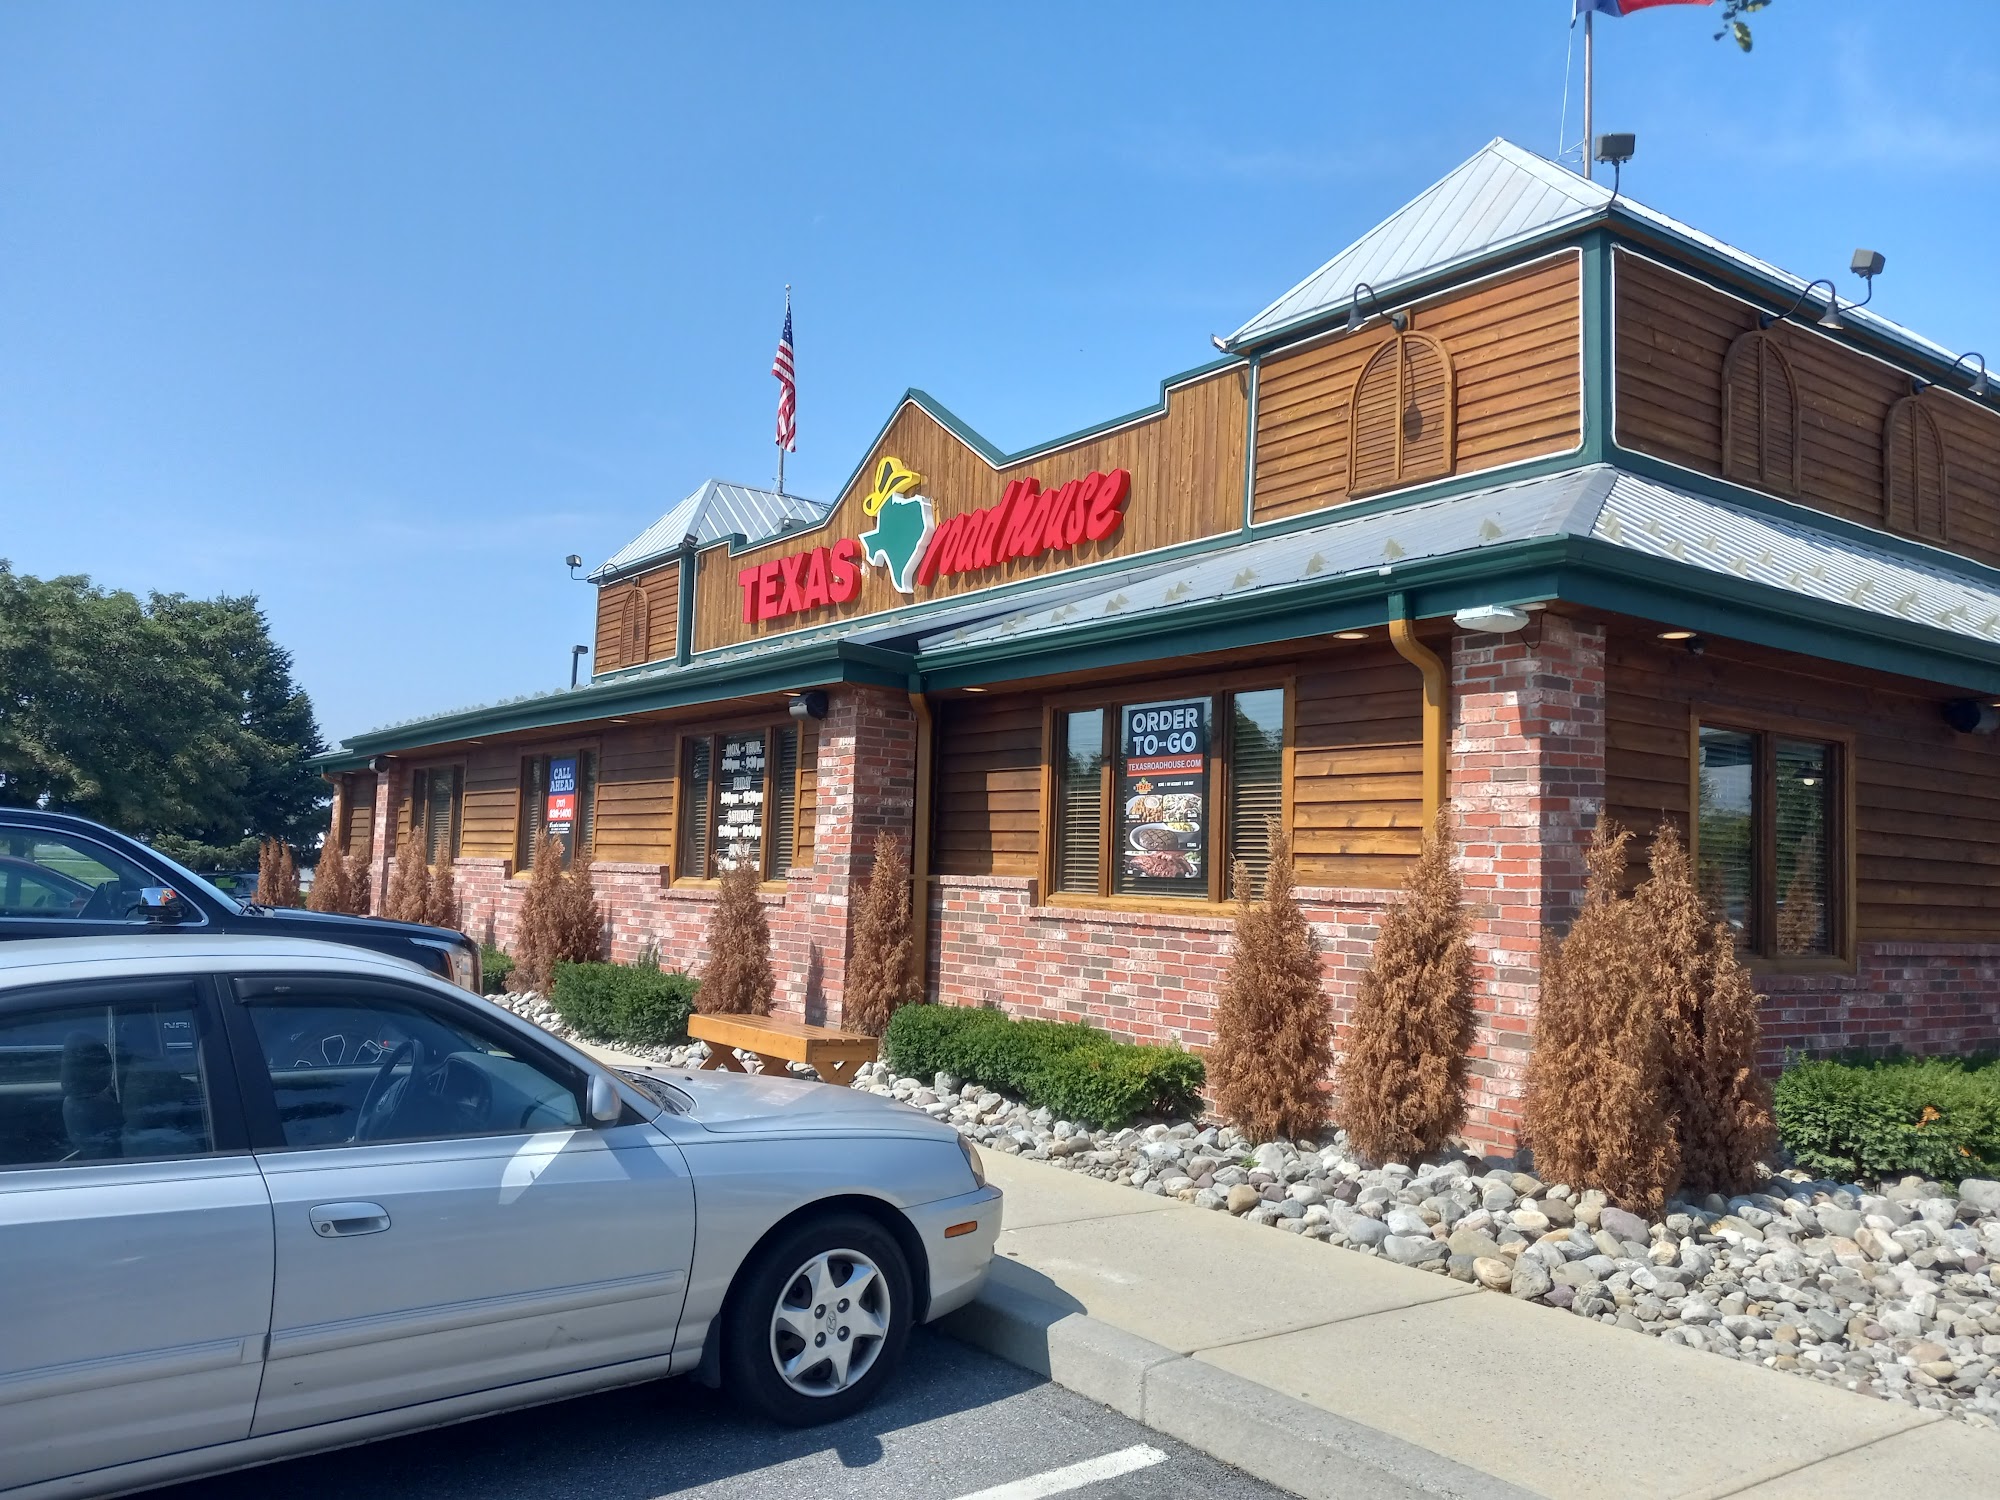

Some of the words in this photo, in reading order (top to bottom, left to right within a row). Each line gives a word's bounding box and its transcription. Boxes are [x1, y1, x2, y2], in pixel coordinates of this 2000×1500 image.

[739, 538, 861, 624] TEXAS
[917, 468, 1131, 586] roadhouse
[1132, 708, 1198, 733] ORDER
[1132, 731, 1197, 755] TO-GO
[1128, 759, 1201, 771] TEXASROADHOUSE.COM
[554, 767, 571, 780] CALL
[550, 779, 574, 792] AHEAD
[733, 776, 752, 790] FRIDAY
[727, 809, 754, 823] SATURDAY
